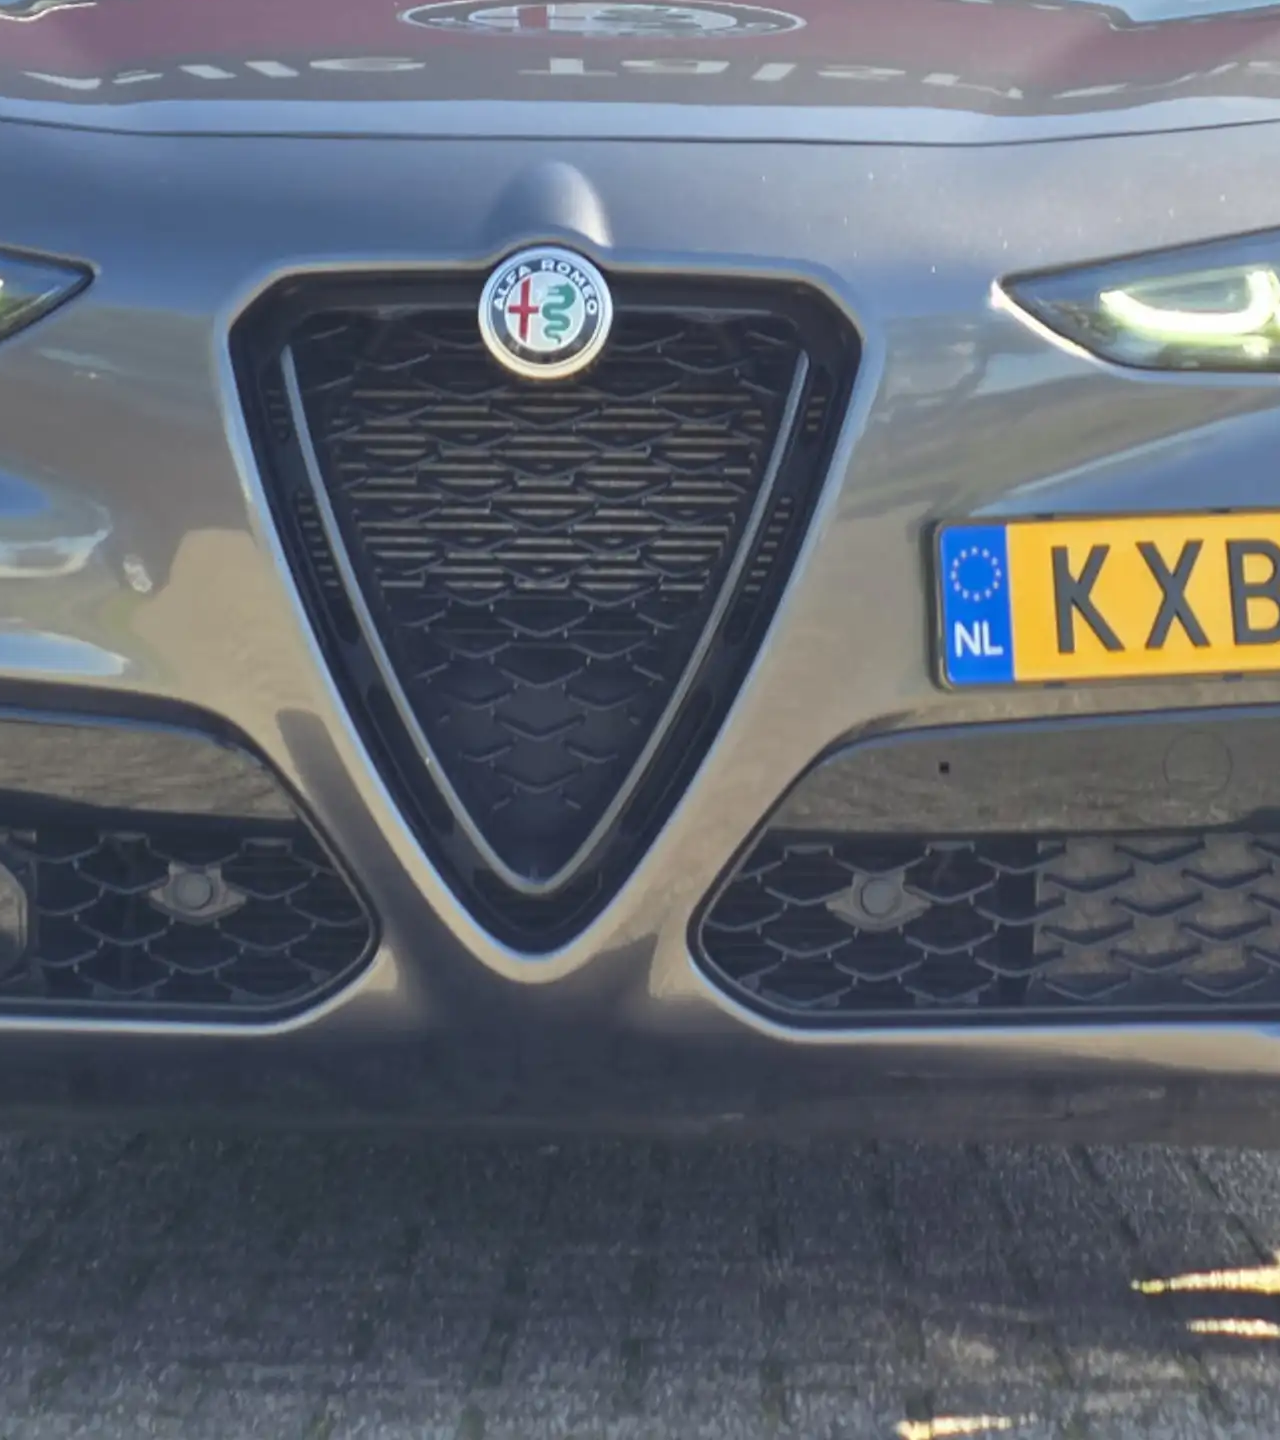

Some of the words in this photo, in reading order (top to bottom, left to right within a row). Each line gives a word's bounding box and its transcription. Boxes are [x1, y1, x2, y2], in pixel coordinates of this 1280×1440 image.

[494, 266, 532, 311] ALFA
[541, 259, 598, 315] ROMEO
[954, 620, 1003, 657] NL
